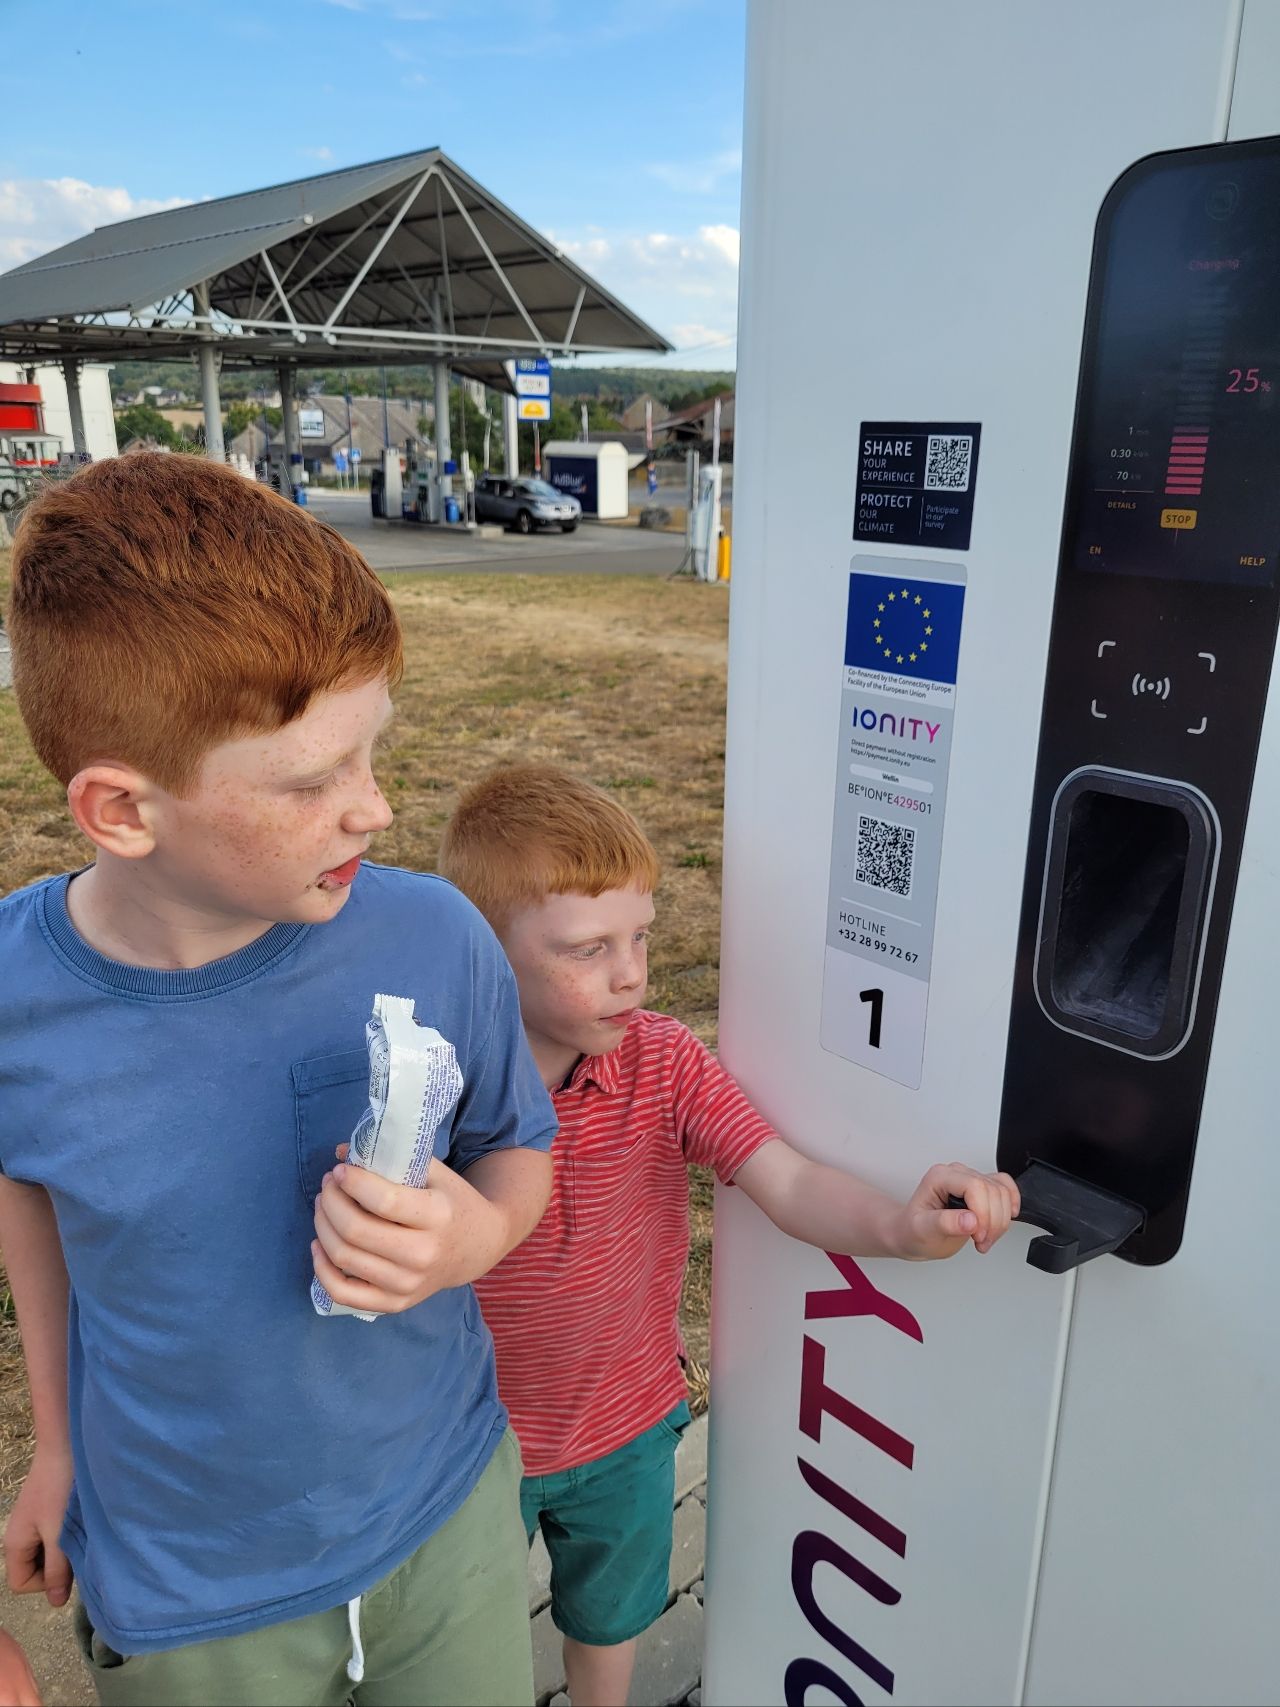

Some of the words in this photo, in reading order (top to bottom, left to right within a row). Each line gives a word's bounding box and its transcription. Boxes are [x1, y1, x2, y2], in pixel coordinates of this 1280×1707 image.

[863, 440, 913, 457] SHARE
[1110, 448, 1132, 459] 0.30
[863, 458, 887, 468] YOUR
[862, 470, 915, 483] EXPERIENCE
[1116, 471, 1129, 481] 70
[860, 493, 913, 508] PROTECT
[1107, 501, 1137, 510] DETAILS
[859, 508, 877, 519] OUR
[926, 504, 959, 515] Participate
[1165, 514, 1192, 524] STOP
[858, 521, 895, 533] CLIMATE
[925, 521, 945, 530] survey
[1089, 546, 1102, 555] EN
[1240, 556, 1266, 566] HELP
[848, 668, 881, 680] Co-financed
[881, 674, 888, 683] by
[888, 675, 897, 684] the
[898, 677, 930, 691] Connecting
[931, 683, 952, 694] Europe
[847, 678, 866, 688] Facility
[873, 682, 882, 690] the
[883, 684, 908, 696] European
[909, 689, 926, 699] Union
[852, 706, 941, 744] IONITY
[851, 738, 866, 747] Direct
[866, 743, 887, 753] payment
[887, 747, 906, 758] without
[907, 752, 936, 764] registration
[839, 911, 887, 937] HOTLINE
[838, 929, 857, 942] +32
[859, 934, 872, 947] 28
[874, 940, 887, 952] 99
[890, 945, 902, 959] 72
[905, 951, 919, 963] 67
[859, 988, 884, 1049] 1
